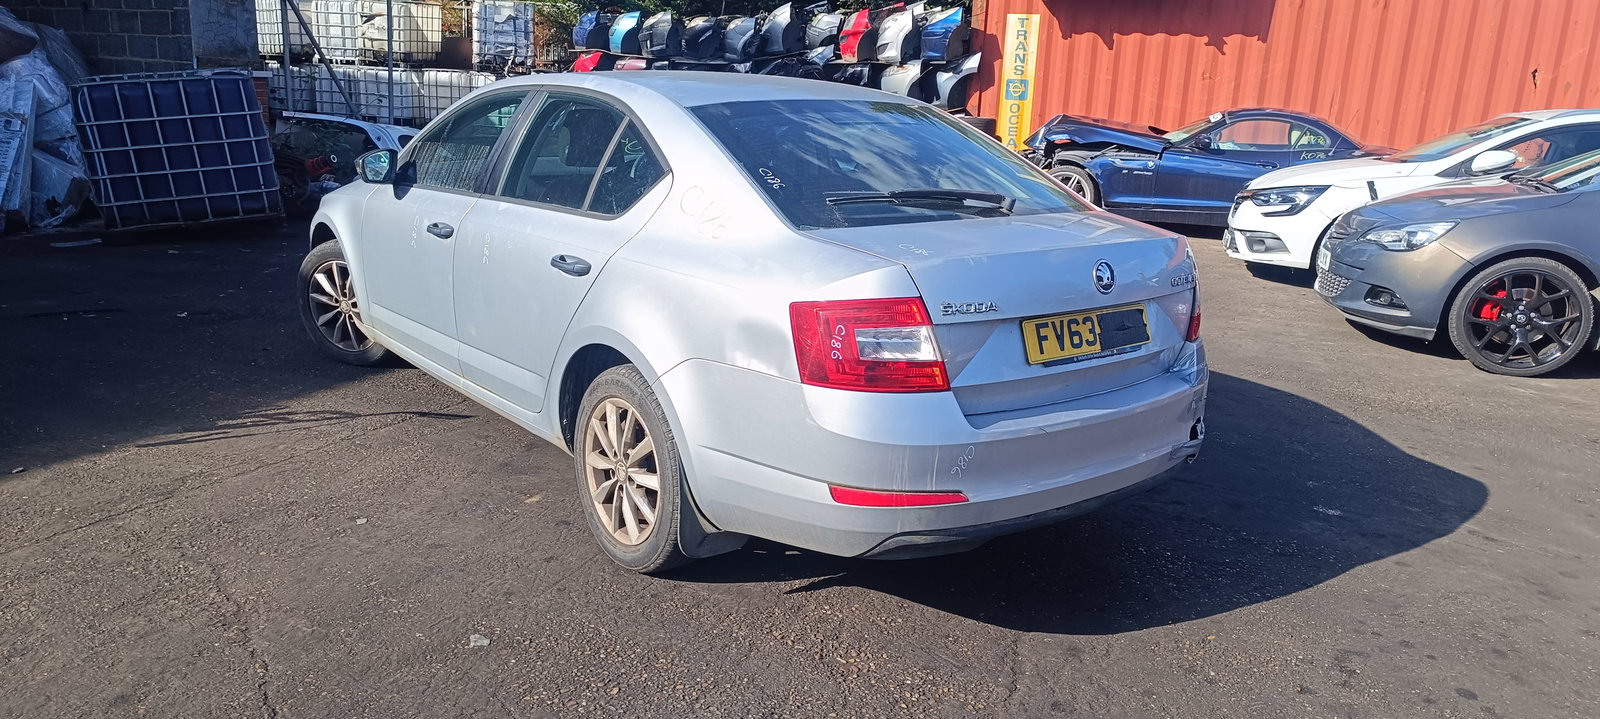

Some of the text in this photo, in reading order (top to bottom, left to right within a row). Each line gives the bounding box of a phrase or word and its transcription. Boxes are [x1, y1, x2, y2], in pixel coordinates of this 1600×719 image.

[1013, 17, 1029, 76] TRANS
[1006, 103, 1021, 150] OCEA
[759, 168, 786, 189] C186
[831, 324, 846, 360] C186
[1034, 315, 1099, 355] FV63
[950, 445, 975, 479] C186
